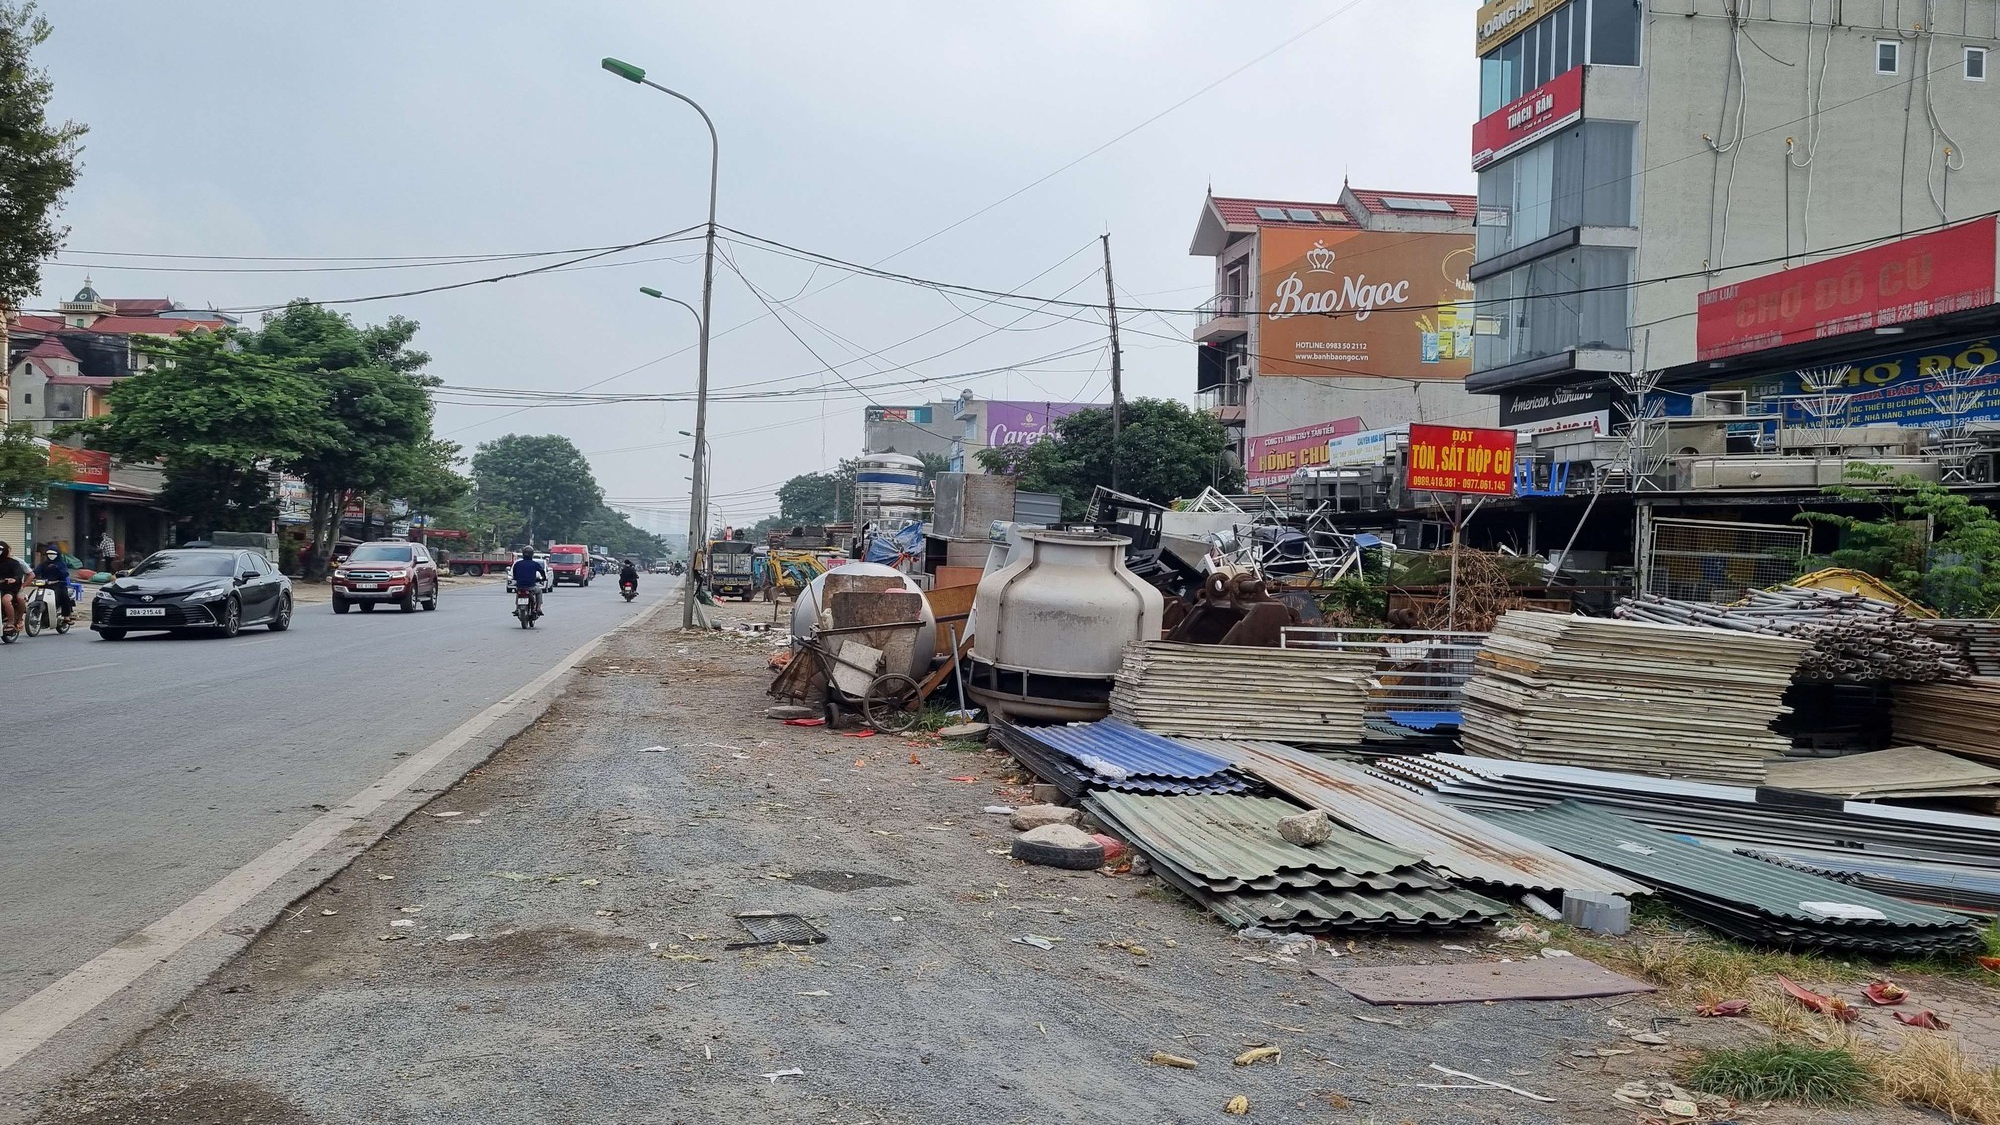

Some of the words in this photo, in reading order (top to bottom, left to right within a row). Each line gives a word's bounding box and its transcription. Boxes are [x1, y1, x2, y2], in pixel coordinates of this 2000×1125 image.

[1326, 342, 1342, 350] 0983
[1342, 342, 1350, 350] 50
[1351, 342, 1368, 350] 2112
[1295, 352, 1369, 362] www.banhbaongoc.vn
[1510, 396, 1550, 414] American
[1452, 430, 1474, 443] ĐẠT
[1258, 448, 1296, 472] HỒNG
[1441, 441, 1464, 472] SẮT
[1466, 445, 1492, 476] HỘP
[1494, 447, 1512, 475] CŨ
[1413, 476, 1456, 488] 0989.418.381
[1462, 478, 1506, 490] 0977.061.145
